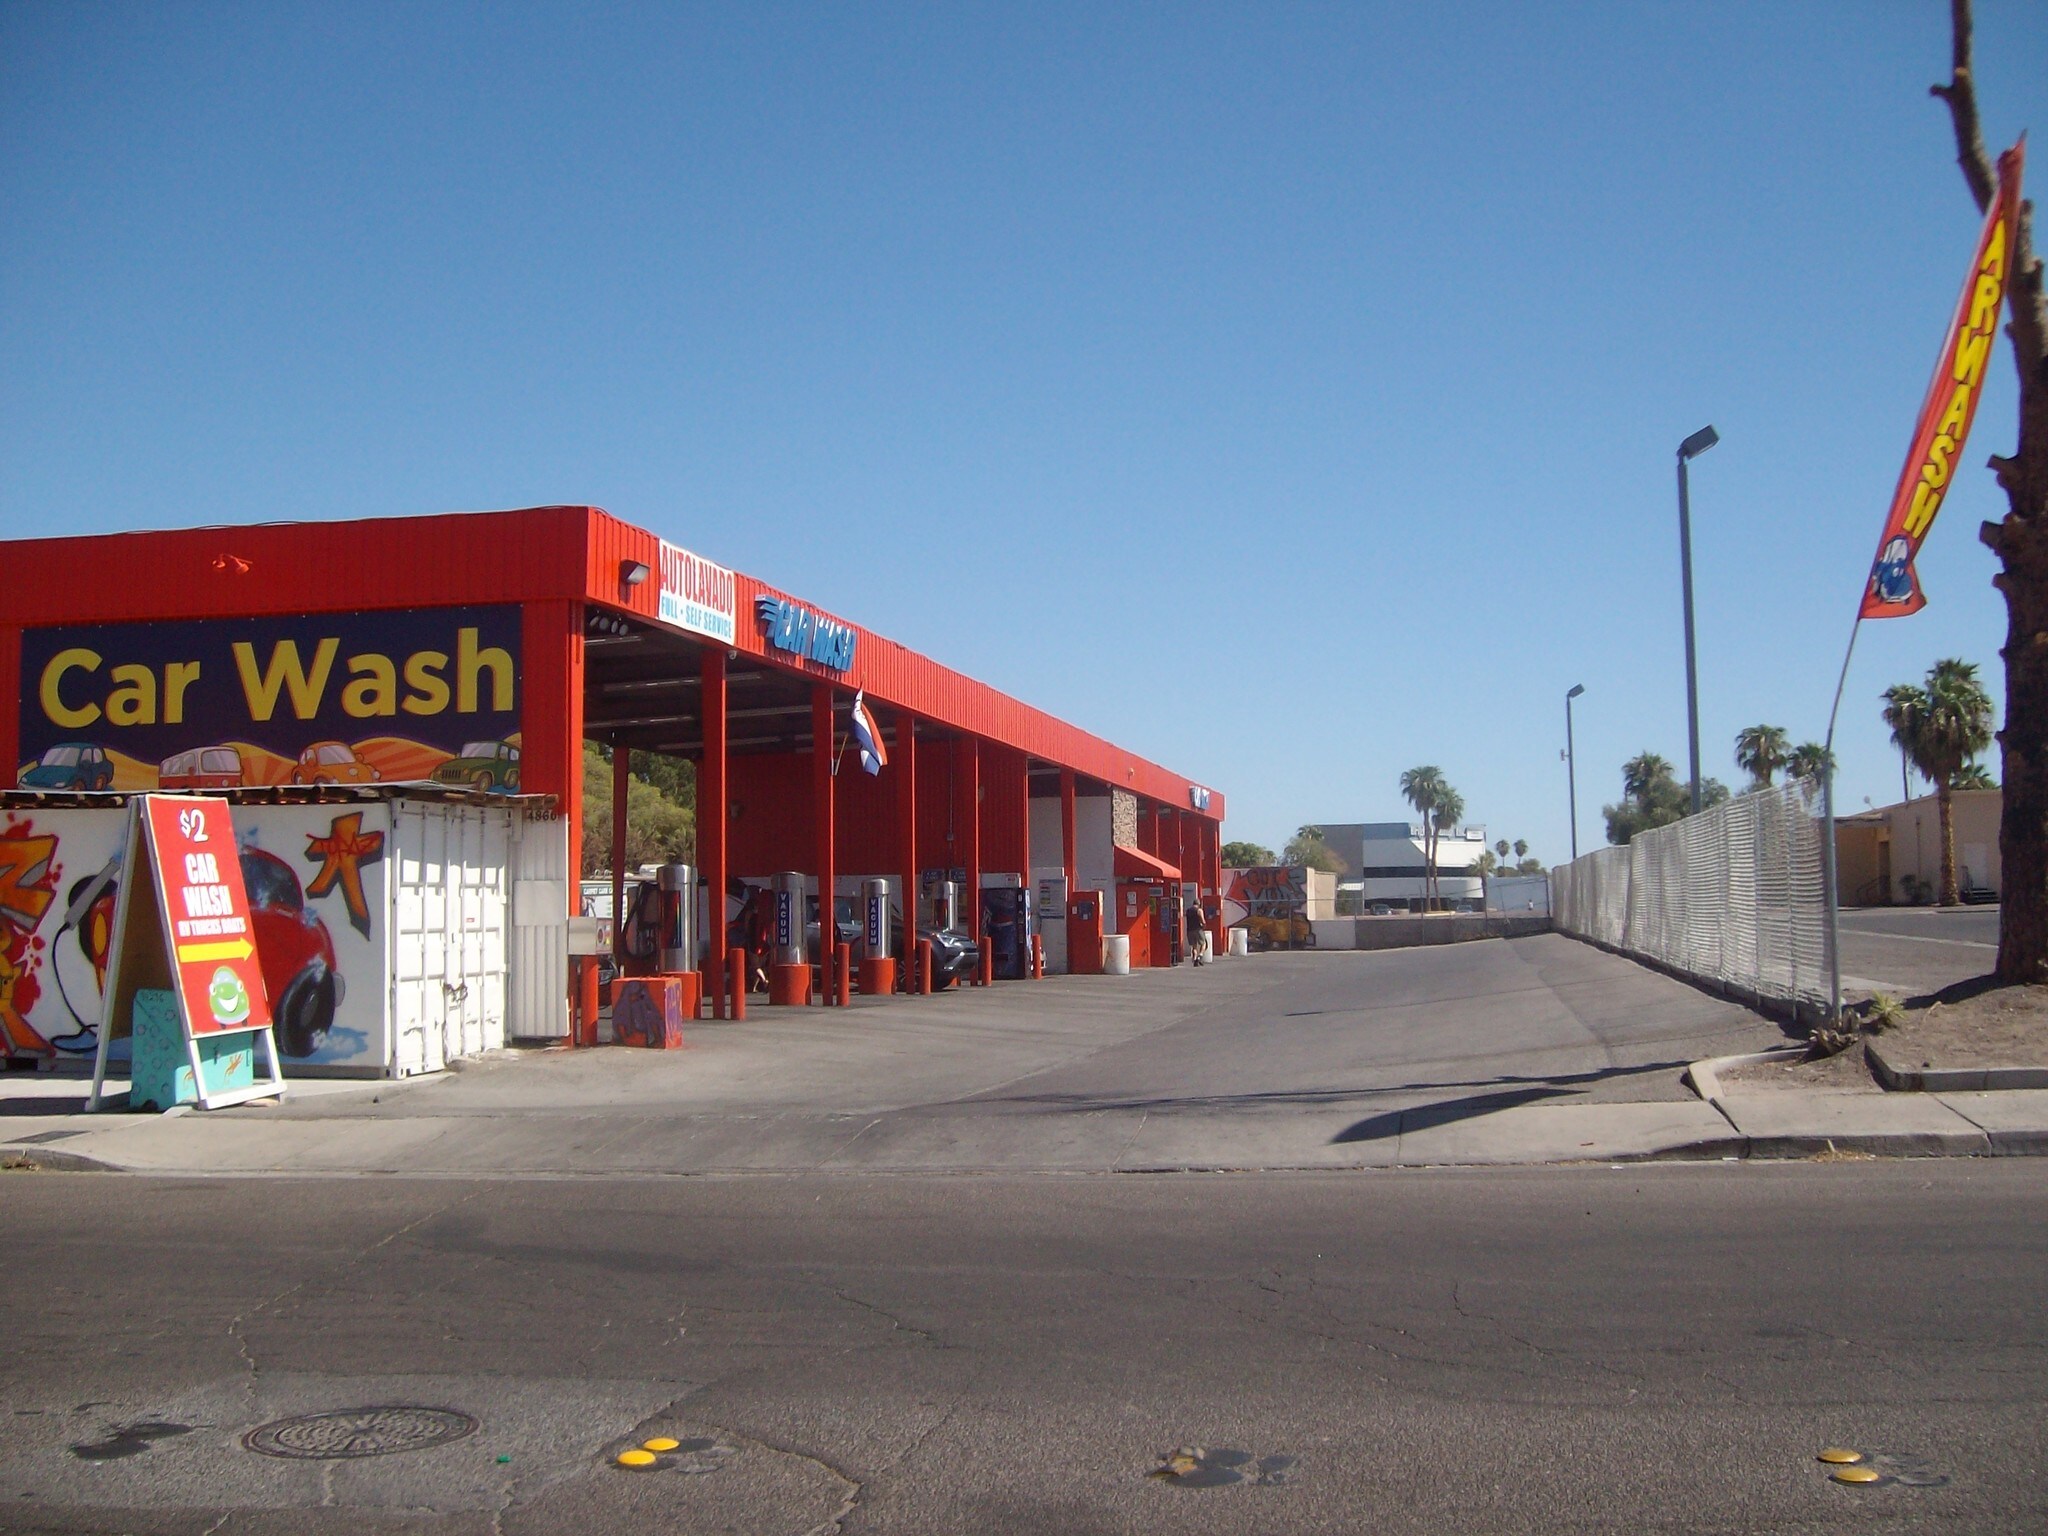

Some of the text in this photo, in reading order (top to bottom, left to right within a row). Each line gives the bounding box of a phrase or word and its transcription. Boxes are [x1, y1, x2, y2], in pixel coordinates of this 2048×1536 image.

[660, 545, 733, 616] AUTOLAVADO
[661, 595, 678, 620] FULL
[686, 604, 702, 629] SELF
[704, 615, 732, 639] SERVICE
[773, 600, 857, 672] CAR WASH
[40, 627, 514, 728] Car Wash
[179, 808, 209, 842] $2
[185, 852, 220, 884] CAR
[182, 885, 234, 917] WASH
[191, 918, 222, 936] TRUCKS
[222, 917, 247, 934] BOATS
